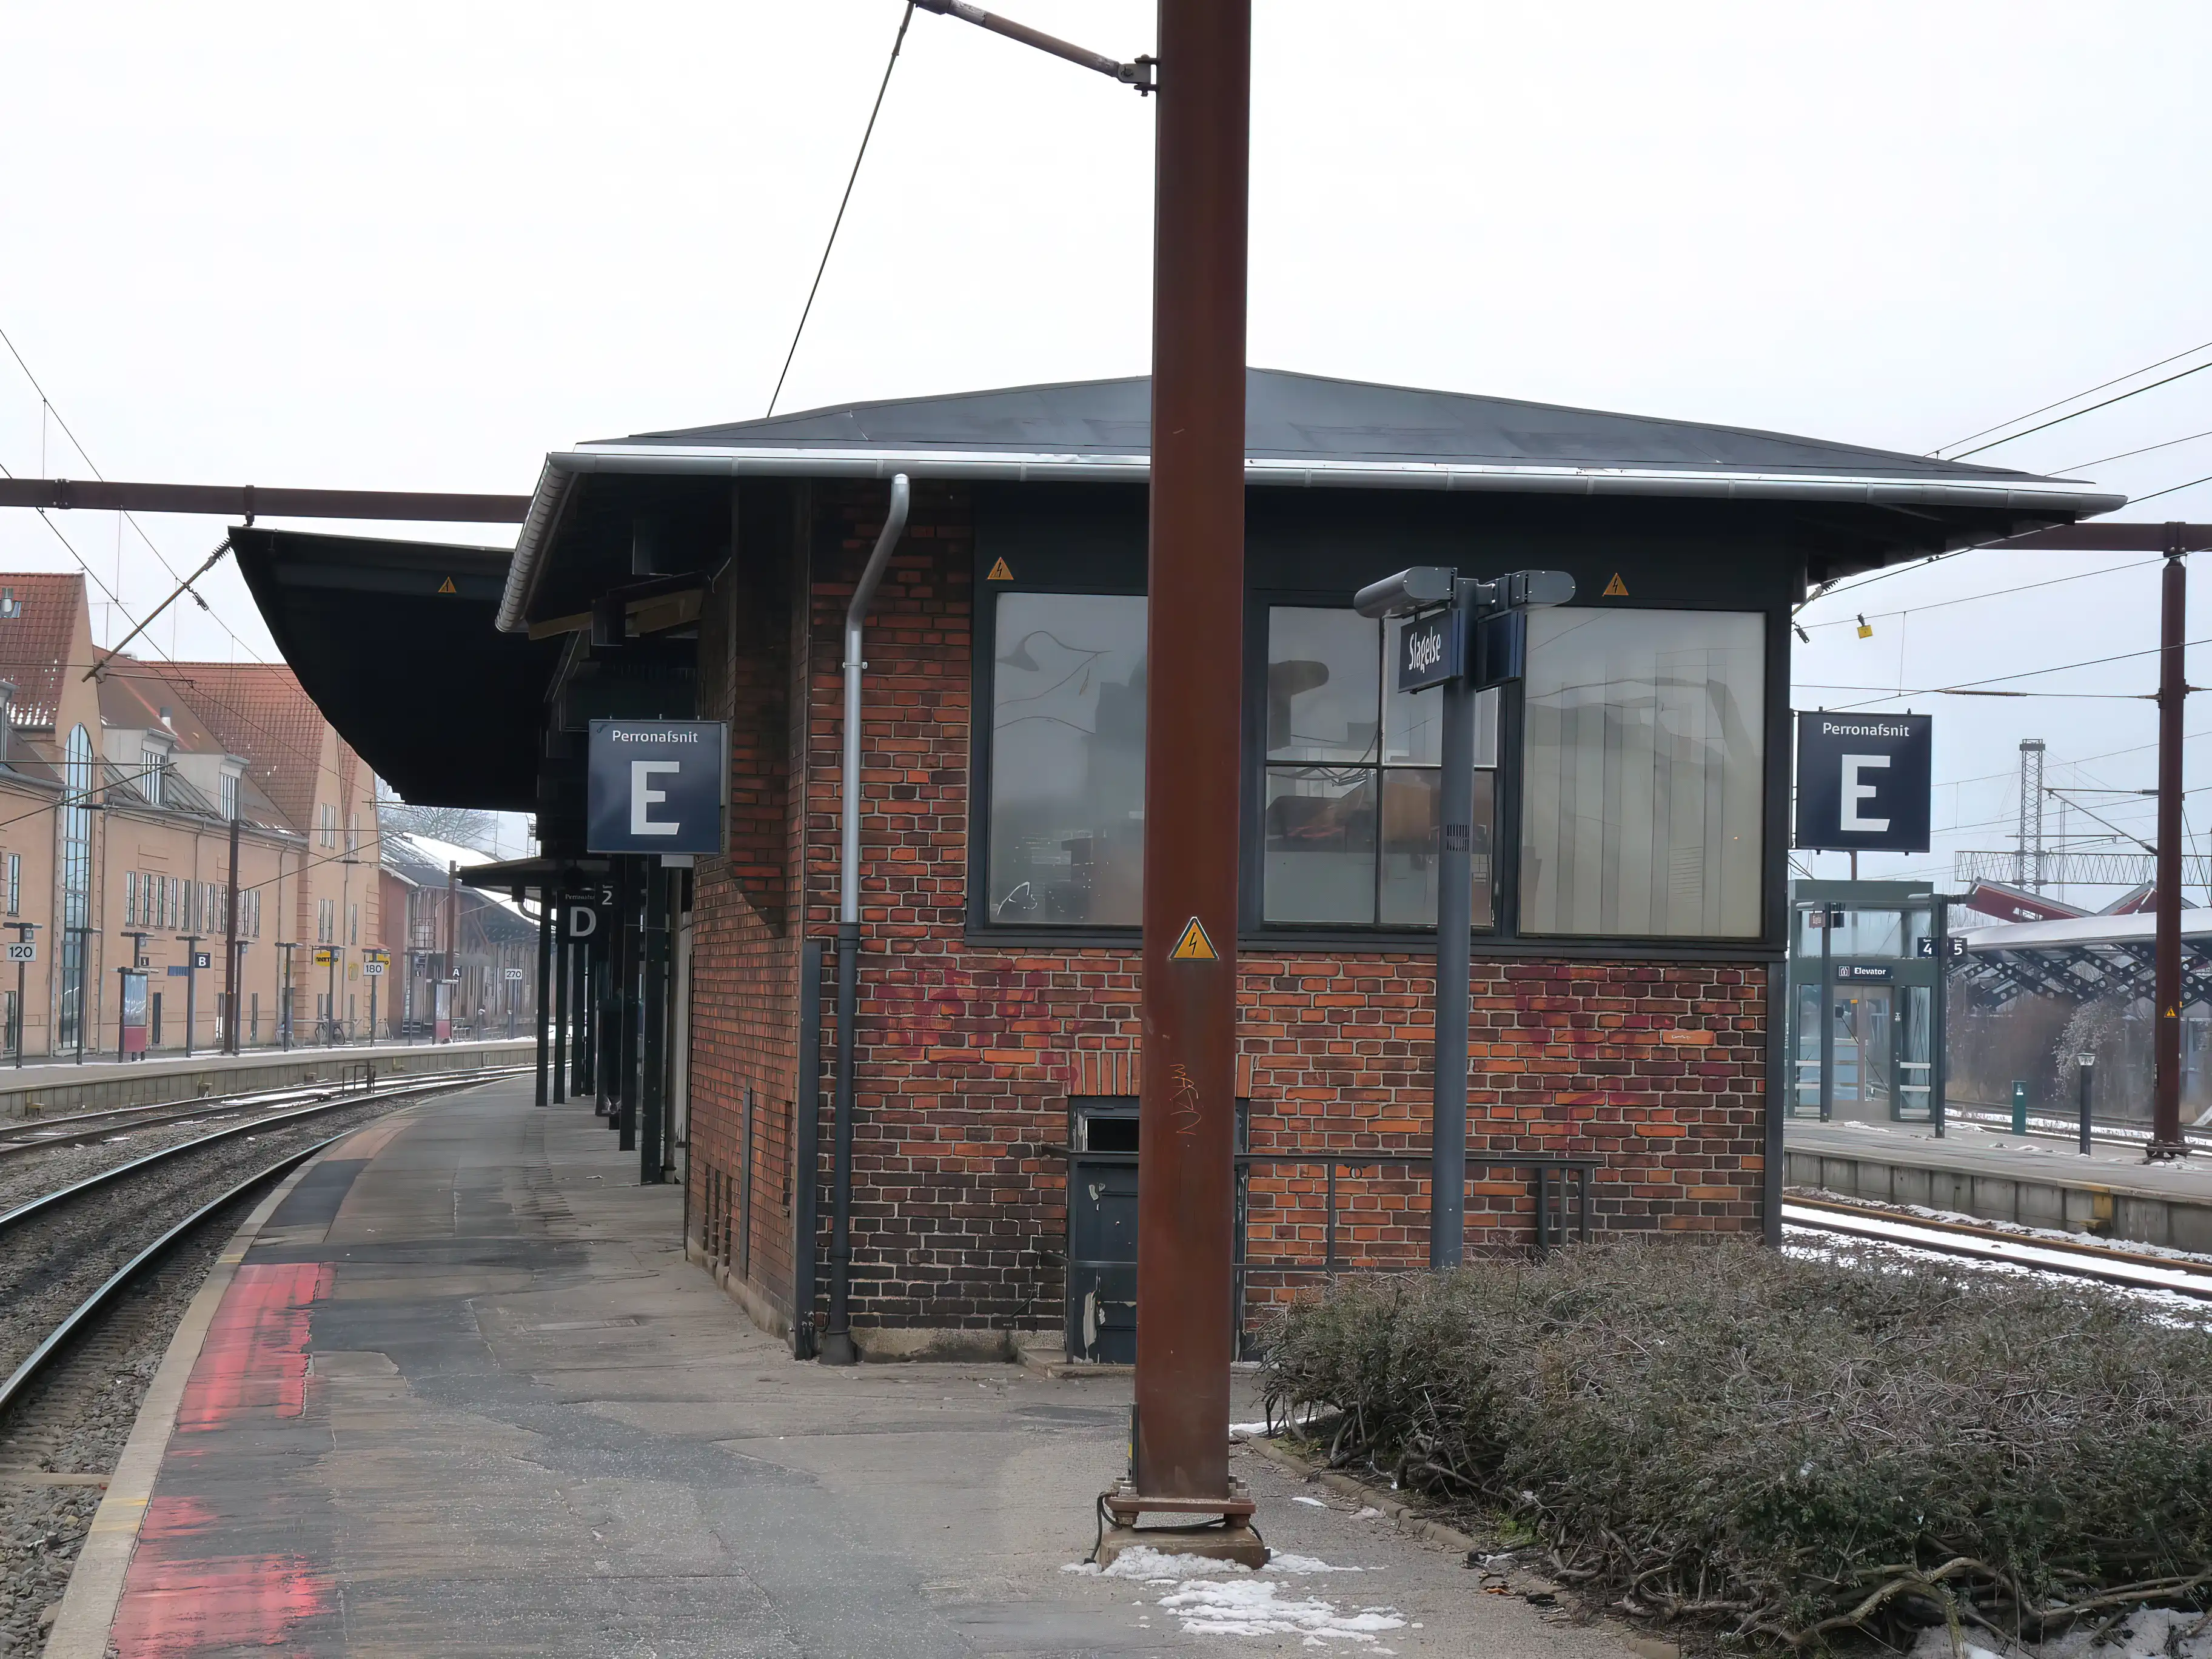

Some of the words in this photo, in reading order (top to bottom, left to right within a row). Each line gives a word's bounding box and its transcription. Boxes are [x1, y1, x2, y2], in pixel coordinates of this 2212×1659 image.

[1409, 626, 1441, 674] Slagelse
[612, 729, 698, 743] Perronafsnit
[1823, 722, 1909, 737] Perronafsnit
[631, 760, 680, 836] E
[1840, 754, 1891, 832] E
[602, 890, 612, 905] 2
[569, 906, 597, 937] D
[9, 946, 33, 958] 120
[1923, 943, 1932, 954] 4
[1954, 943, 1963, 956] 5
[198, 956, 206, 967] B
[366, 964, 382, 973] 180
